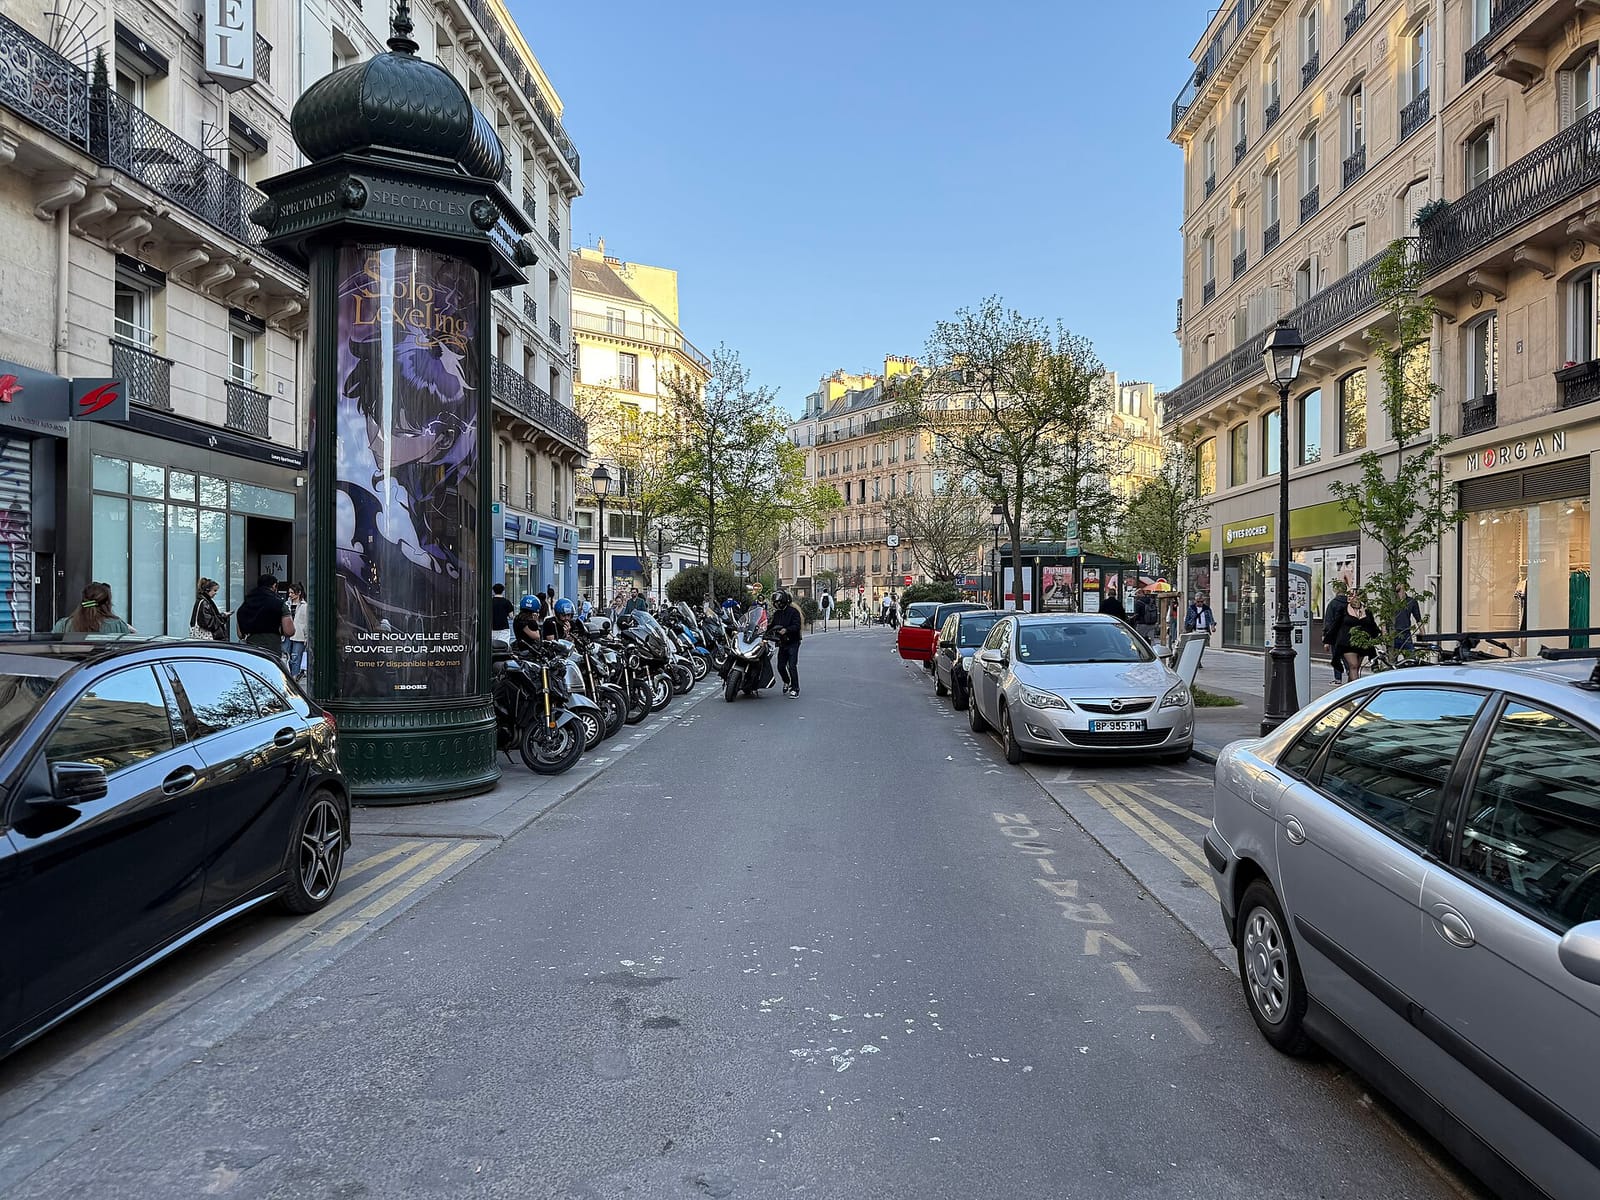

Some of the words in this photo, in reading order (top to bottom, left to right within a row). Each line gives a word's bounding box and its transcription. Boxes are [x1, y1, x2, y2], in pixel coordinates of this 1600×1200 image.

[279, 190, 336, 217] SPECTACLES
[372, 190, 466, 217] SPECTACLES
[354, 251, 433, 302] Solo
[352, 294, 469, 347] Leveling
[1466, 431, 1566, 472] MORGAN
[1245, 525, 1267, 536] ROCHER
[344, 645, 393, 653] S'OUVRE
[395, 645, 428, 653] POUR
[442, 632, 459, 640] ÈRE
[355, 660, 376, 668] Tome
[386, 660, 426, 669] disponible
